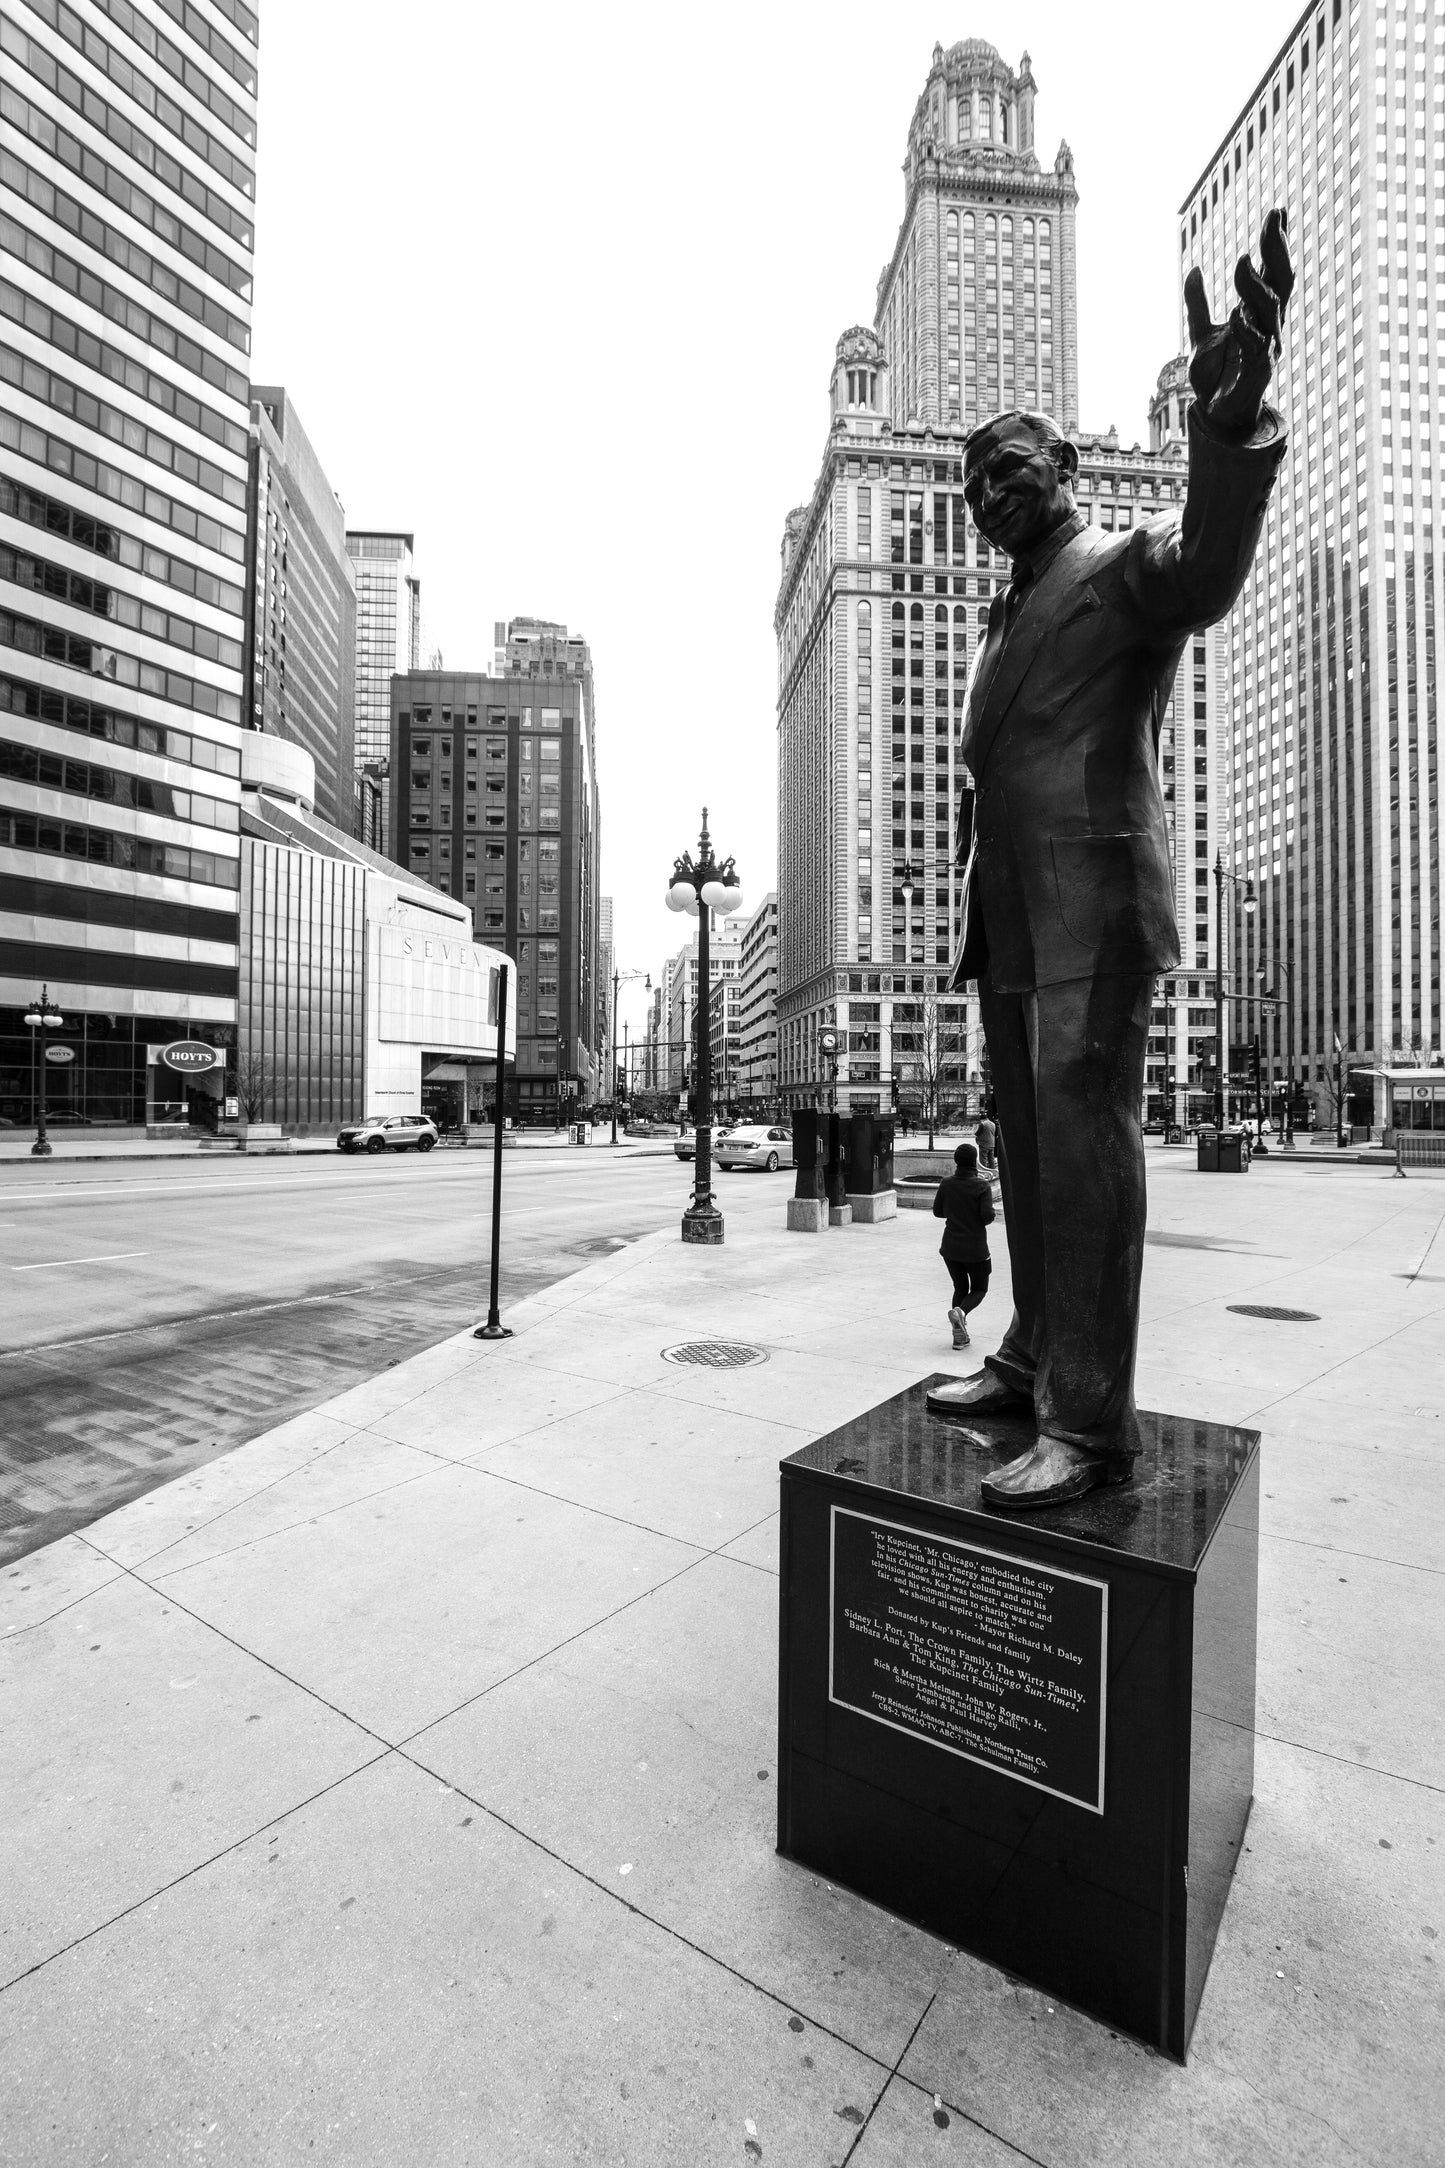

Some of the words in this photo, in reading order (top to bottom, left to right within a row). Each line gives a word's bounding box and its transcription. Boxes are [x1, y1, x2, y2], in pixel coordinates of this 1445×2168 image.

[255, 634, 264, 685] THE
[871, 1559, 906, 1576] television
[934, 1578, 951, 1591] Kup
[952, 1585, 967, 1596] was
[969, 1590, 998, 1606] honest,
[1000, 1601, 1035, 1617] accurate
[1037, 1613, 1052, 1623] and
[876, 1541, 886, 1551] he
[887, 1544, 907, 1557] loved
[908, 1552, 925, 1563] with
[927, 1558, 937, 1567] all
[939, 1560, 951, 1571] his
[952, 1565, 979, 1580] energy
[980, 1575, 995, 1585] and
[997, 1581, 1046, 1601] enthusiasm.
[876, 1550, 884, 1560] In
[885, 1553, 897, 1564] his
[898, 1558, 929, 1573] Chicago
[930, 1568, 970, 1587] Sun-Times
[971, 1582, 1001, 1597] column
[1003, 1592, 1019, 1602] and
[1020, 1598, 1032, 1606] on
[1033, 1599, 1047, 1611] his
[887, 1535, 922, 1553] Kupcinet,
[980, 1565, 1020, 1582] embodied
[1022, 1576, 1036, 1587] the
[1037, 1581, 1055, 1594] city
[877, 1569, 892, 1582] fair,
[893, 1576, 907, 1586] and
[908, 1580, 920, 1590] his
[921, 1585, 969, 1606] commitment
[970, 1601, 979, 1609] to
[980, 1605, 1009, 1620] charity
[1011, 1614, 1027, 1625] was
[1029, 1620, 1045, 1631] one
[899, 1587, 909, 1596] we
[911, 1591, 936, 1605] should
[937, 1600, 948, 1609] all
[949, 1605, 973, 1617] aspire
[975, 1612, 983, 1620] to
[844, 1608, 872, 1626] Sidney
[874, 1619, 883, 1629] L.
[885, 1622, 906, 1638] Port,
[907, 1631, 925, 1644] The
[926, 1638, 956, 1656] Crown
[959, 1649, 993, 1670] Family,
[996, 1662, 1015, 1677] The
[1017, 1669, 1045, 1688] Wirtz
[1047, 1680, 1086, 1704] Family,
[888, 1606, 918, 1623] Donated
[920, 1617, 930, 1628] by
[931, 1621, 954, 1635] Kup's
[956, 1629, 985, 1646] Friends
[987, 1642, 1002, 1652] and
[1004, 1646, 1032, 1663] family
[980, 1622, 1006, 1638] Mayor
[1008, 1631, 1041, 1650] Richard
[1043, 1643, 1054, 1654] M.
[1057, 1648, 1083, 1665] Daley
[849, 1620, 881, 1639] Barbara
[882, 1633, 900, 1646] Ann
[902, 1640, 911, 1650] &
[913, 1643, 932, 1658] Tom
[934, 1651, 960, 1669] King,
[962, 1661, 979, 1675] The
[982, 1669, 1022, 1690] Chicago
[1024, 1684, 1080, 1713] Sun-Times,
[873, 1658, 891, 1672] Rich
[892, 1666, 899, 1675] &
[901, 1668, 928, 1686] Martha
[929, 1680, 963, 1700] Melman,
[965, 1693, 984, 1707] John
[985, 1701, 997, 1713] W.
[999, 1706, 1031, 1726] Rogers,
[1033, 1719, 1047, 1732] Jr.,
[909, 1652, 926, 1666] The
[929, 1660, 970, 1683] Kupcinet
[972, 1675, 1005, 1697] Family
[871, 1691, 887, 1704] Jerry
[887, 1697, 919, 1716] Reinsdorf,
[920, 1710, 946, 1727] Johnson
[946, 1721, 983, 1742] Publishing,
[984, 1736, 1015, 1755] Northern
[1015, 1748, 1034, 1763] Trust
[1035, 1757, 1048, 1768] Co.
[895, 1675, 915, 1689] Steve
[917, 1683, 956, 1705] Lombardo
[957, 1700, 972, 1711] and
[974, 1705, 996, 1720] Hugo
[998, 1715, 1021, 1731] Ralli,
[915, 1692, 938, 1707] Angel
[940, 1701, 947, 1710] &
[949, 1704, 967, 1718] Paul
[969, 1712, 998, 1731] Harvey
[878, 1702, 900, 1717] CBS-2,
[901, 1711, 938, 1733] WMAQ-TV,
[939, 1728, 964, 1743] ABC-7,
[965, 1737, 978, 1748] The
[979, 1743, 1012, 1762] Schulman
[1013, 1756, 1040, 1774] Family.
